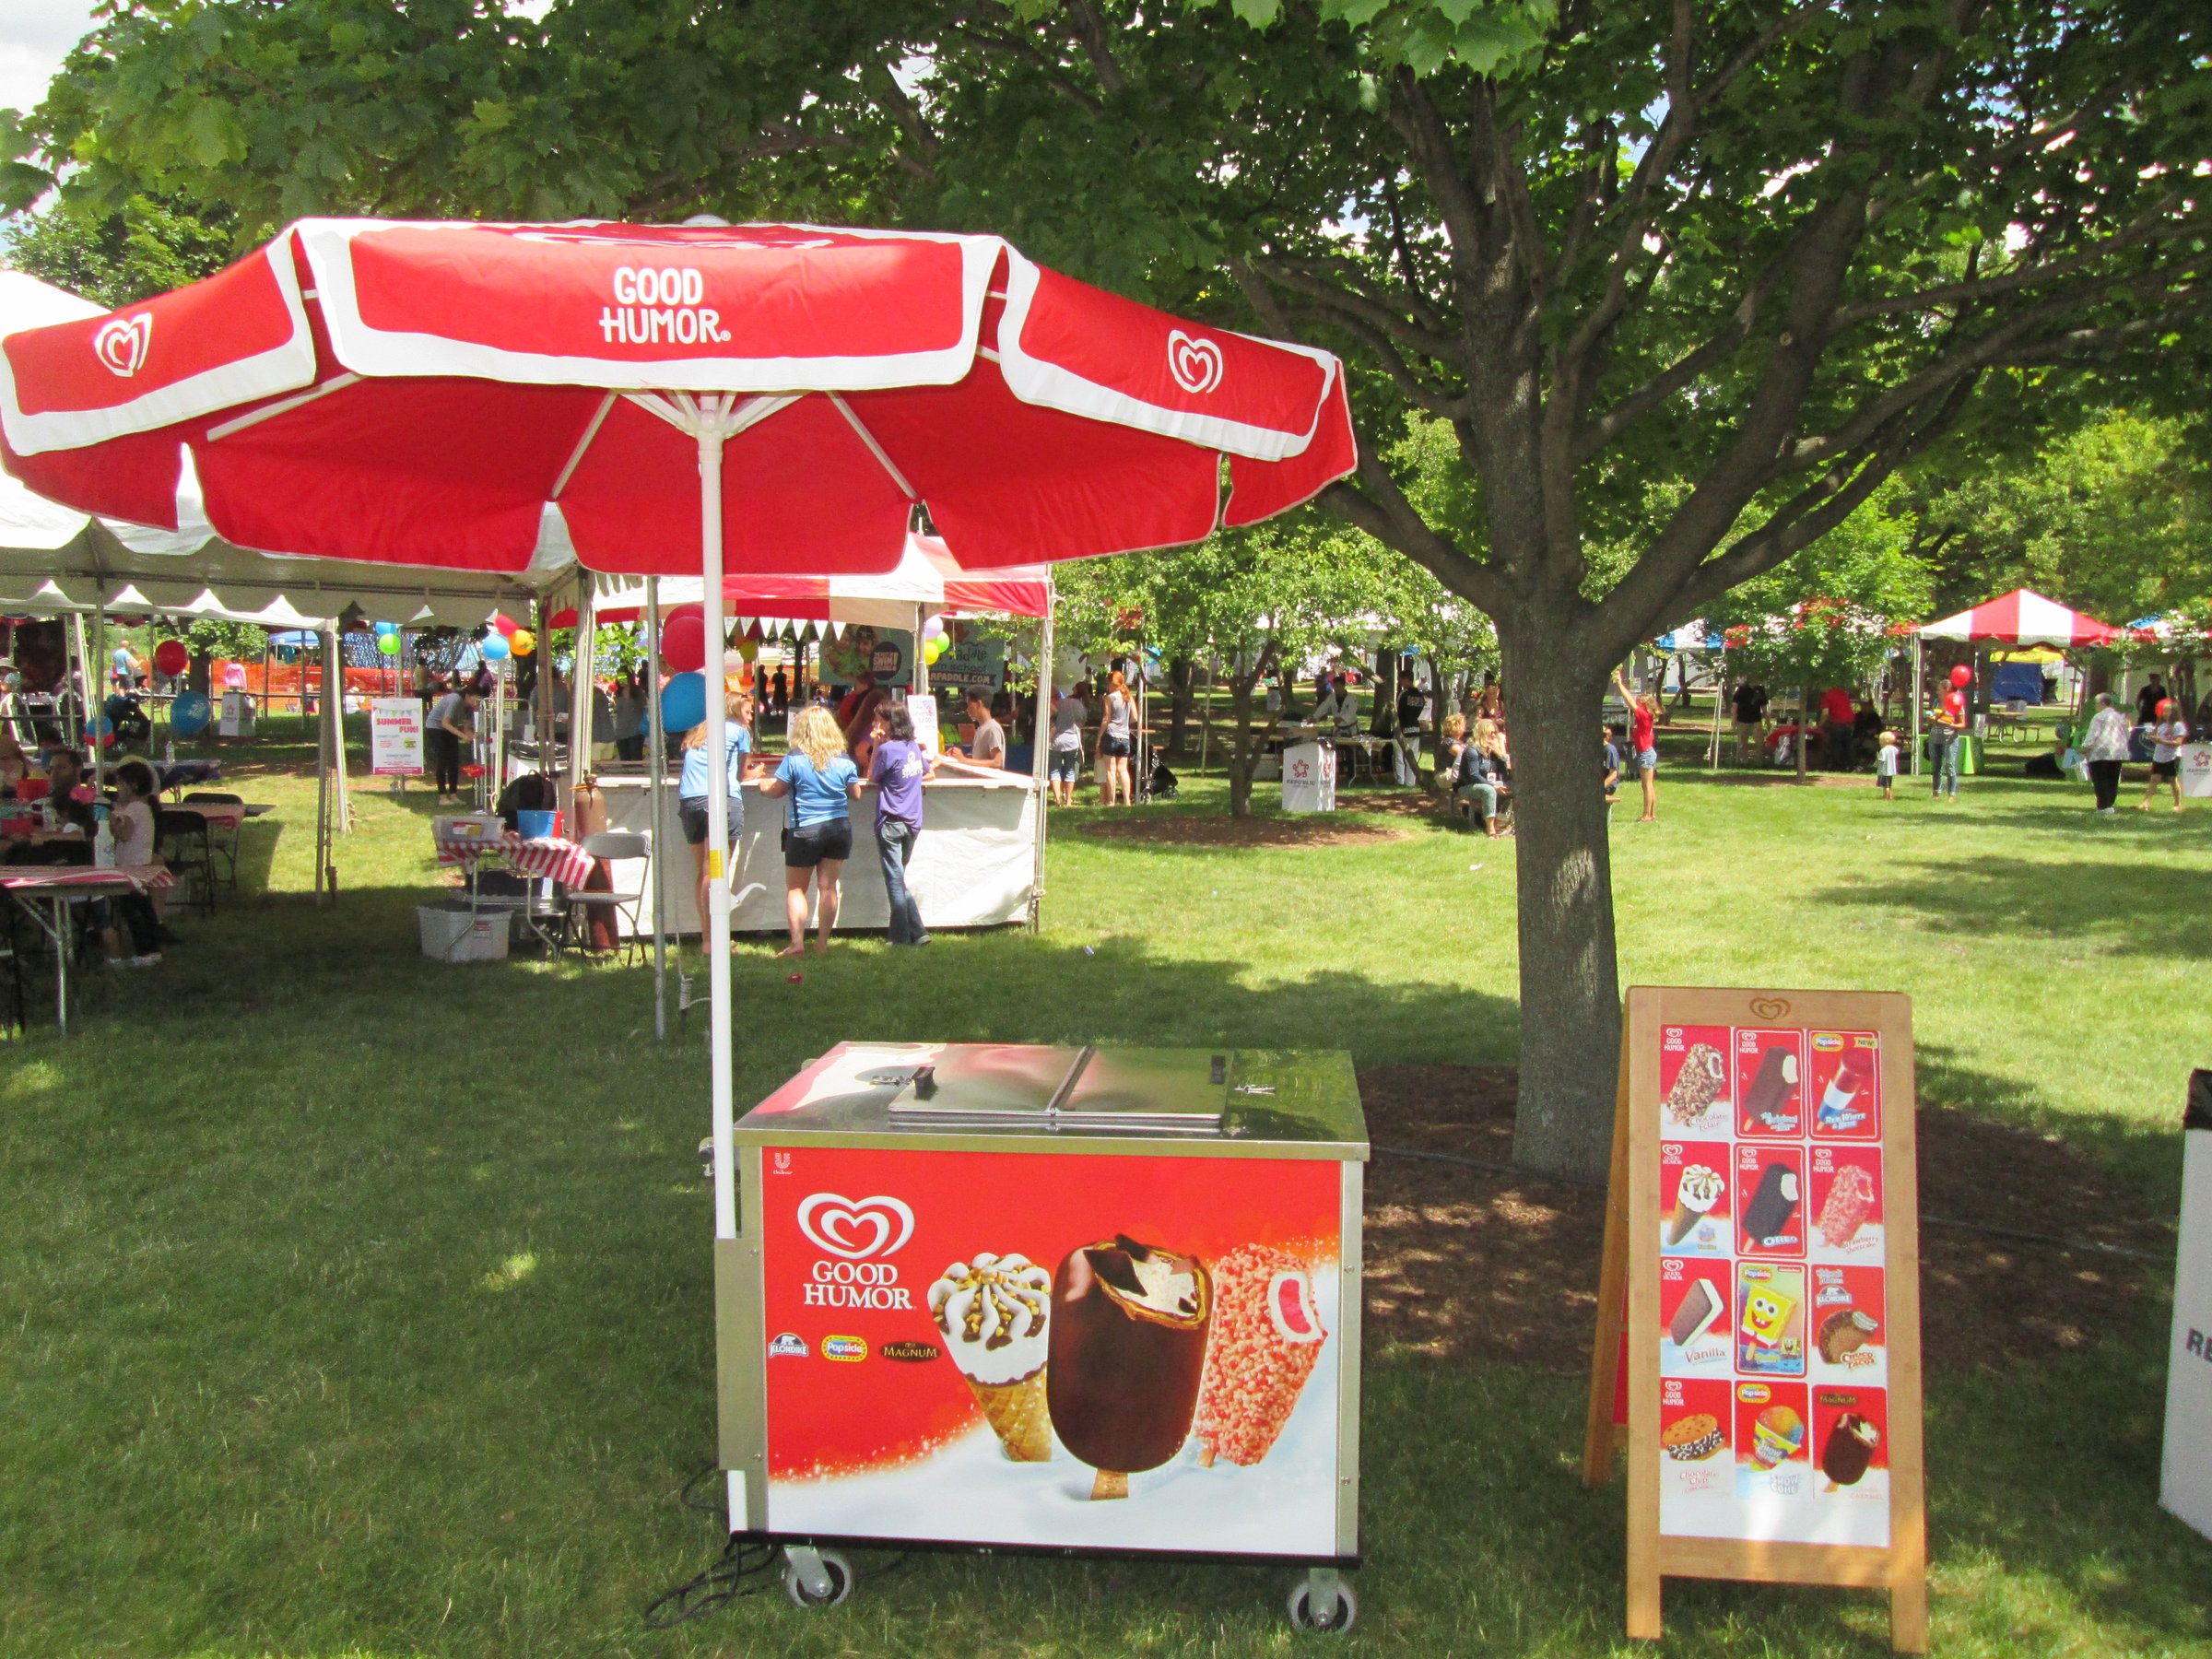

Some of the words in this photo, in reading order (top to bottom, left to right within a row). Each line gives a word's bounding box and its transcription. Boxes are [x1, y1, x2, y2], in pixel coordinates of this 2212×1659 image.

[614, 266, 703, 306] GOOD
[376, 717, 412, 726] SUMMER
[399, 725, 419, 734] FUN!
[1812, 1165, 1835, 1173] HUMOR
[1763, 1236, 1798, 1247] OREO
[812, 1260, 899, 1286] GOOD
[803, 1283, 913, 1310] HUMOR
[770, 1344, 808, 1357] KLONDIKE
[827, 1341, 864, 1354] Popsicle
[883, 1347, 938, 1358] MAGNUM
[1685, 1347, 1726, 1363] Vanilla
[1663, 1398, 1685, 1406] HUMOR
[1771, 1474, 1798, 1485] SNOW
